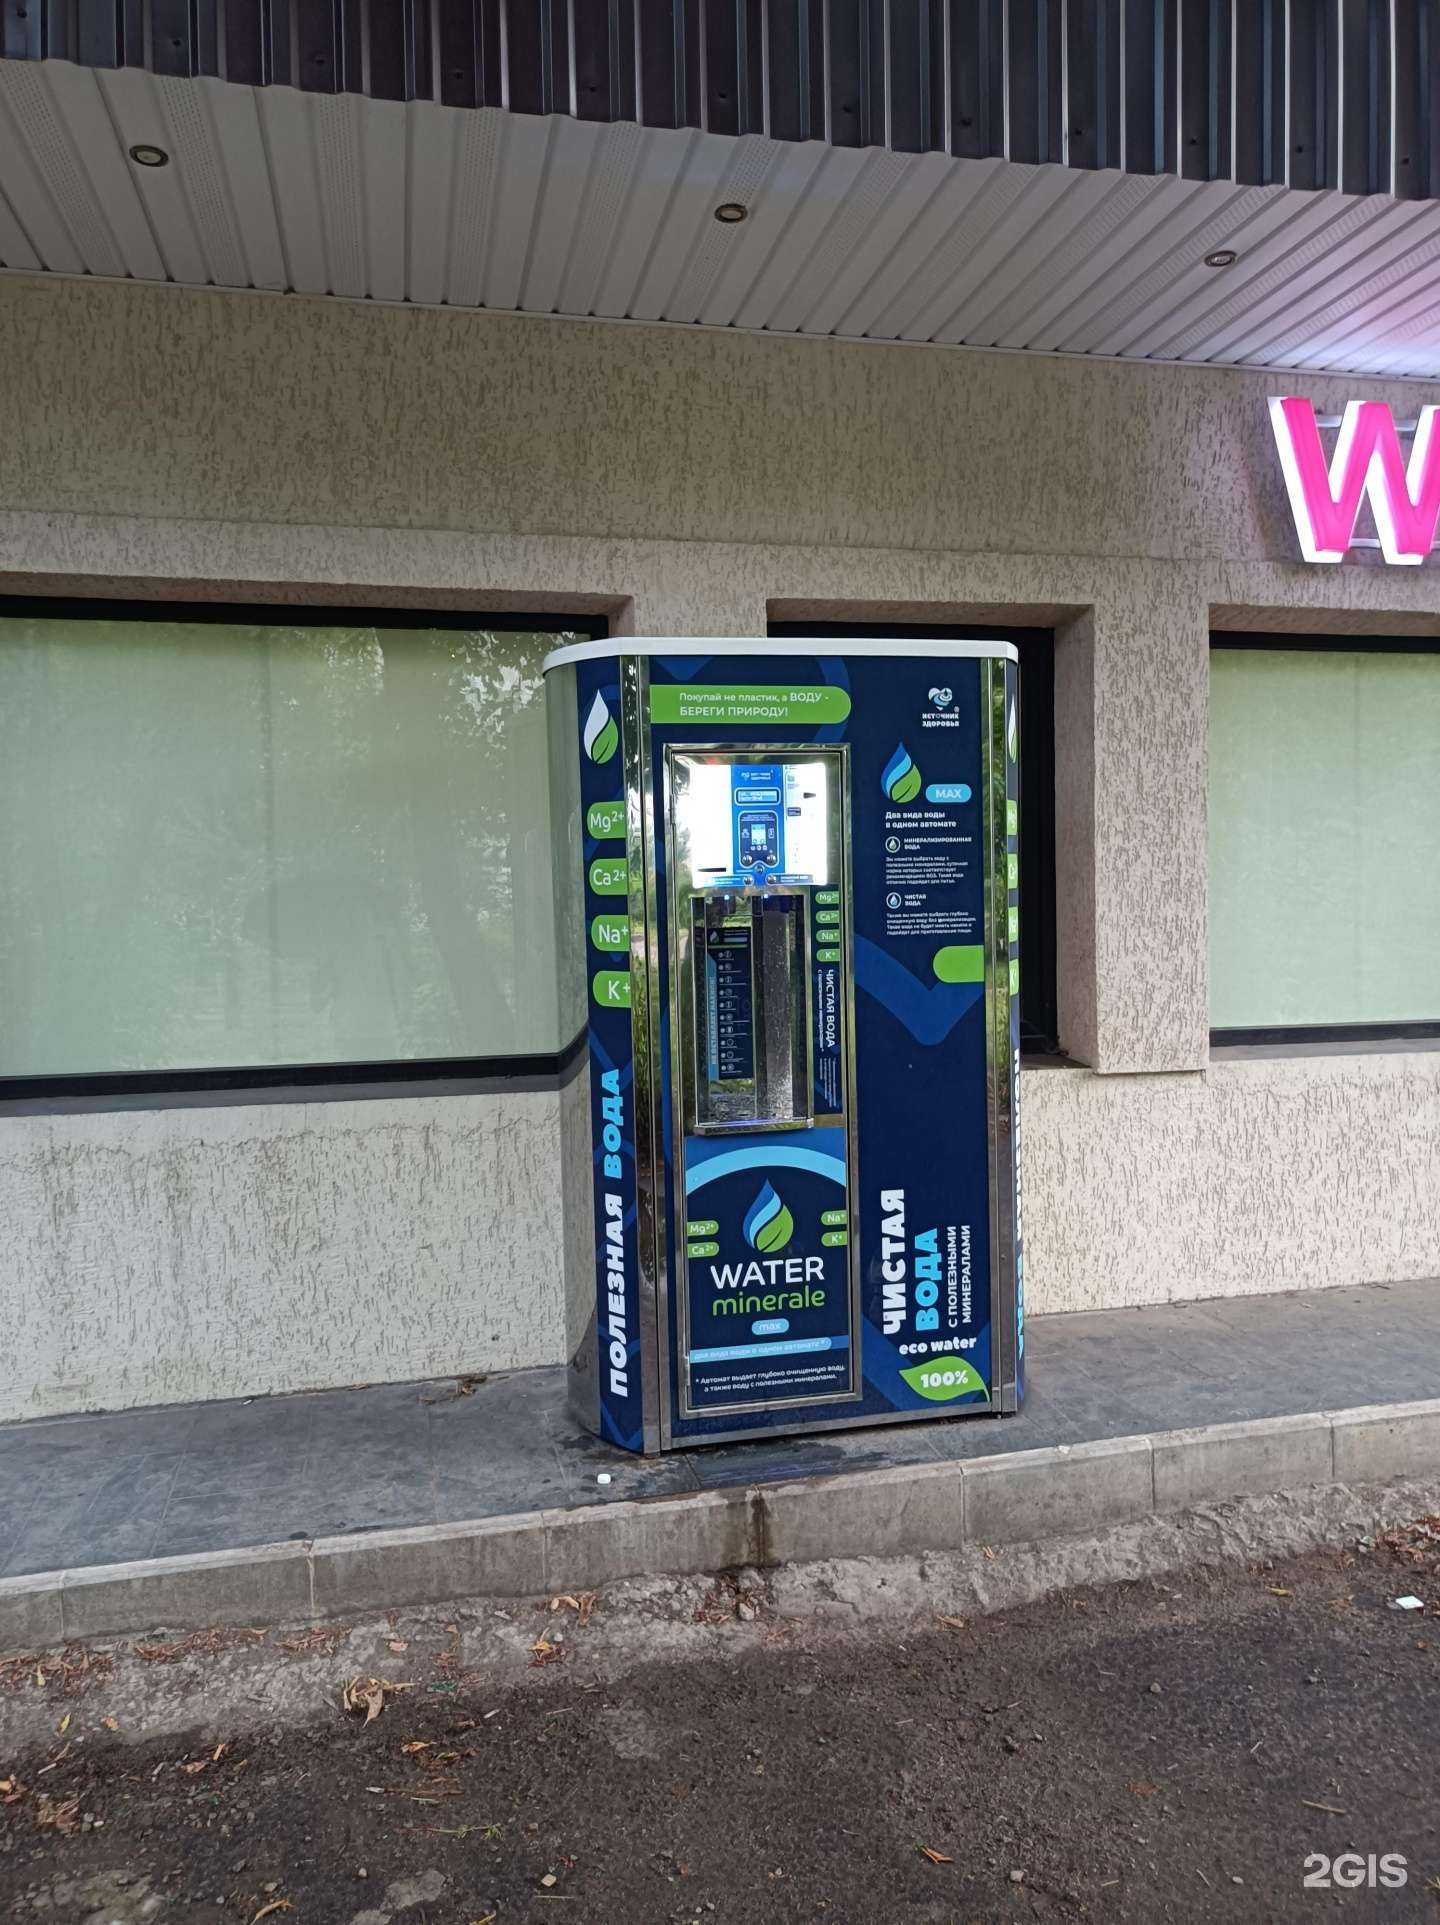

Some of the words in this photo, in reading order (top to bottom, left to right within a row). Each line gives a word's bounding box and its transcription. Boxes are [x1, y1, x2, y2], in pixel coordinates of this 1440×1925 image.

[679, 692, 722, 703] Покупай
[724, 693, 736, 702] не
[738, 693, 780, 703] пластик,
[781, 694, 788, 702] а
[789, 692, 823, 703] ВОДУ
[679, 706, 725, 717] БЕРЕГИ
[727, 706, 789, 718] ПРИРОДУ!
[921, 712, 960, 720] ИСТОЧНИК
[921, 720, 960, 728] ЗДОРОВЬЯ
[935, 789, 962, 799] MAX
[885, 811, 901, 819] Два
[902, 811, 923, 819] вида
[924, 811, 946, 819] воды
[892, 821, 919, 829] одном
[826, 969, 835, 1013] ЧИСТАЯ
[827, 1015, 836, 1048] ВОДА
[602, 1068, 624, 1180] ВОДА
[880, 1188, 907, 1335] ЧИСТАЯ
[947, 1225, 957, 1316] ПОЛЕЗНЫМИ
[709, 1256, 825, 1290] WATER
[914, 1227, 942, 1332] ВОДА
[960, 1224, 972, 1324] МИНЕРАЛАМИ
[604, 1192, 628, 1398] ПОЛЕЗНАЯ
[712, 1285, 826, 1316] minerale
[758, 1323, 781, 1331] max
[899, 1341, 928, 1355] eco
[931, 1336, 977, 1352] water
[700, 1375, 731, 1385] Автомат
[731, 1373, 757, 1382] выдает
[757, 1370, 785, 1379] глубоко
[786, 1366, 827, 1376] очищенную
[710, 1384, 732, 1392] также
[755, 1378, 794, 1387] полезными
[920, 1370, 969, 1388] 100%
